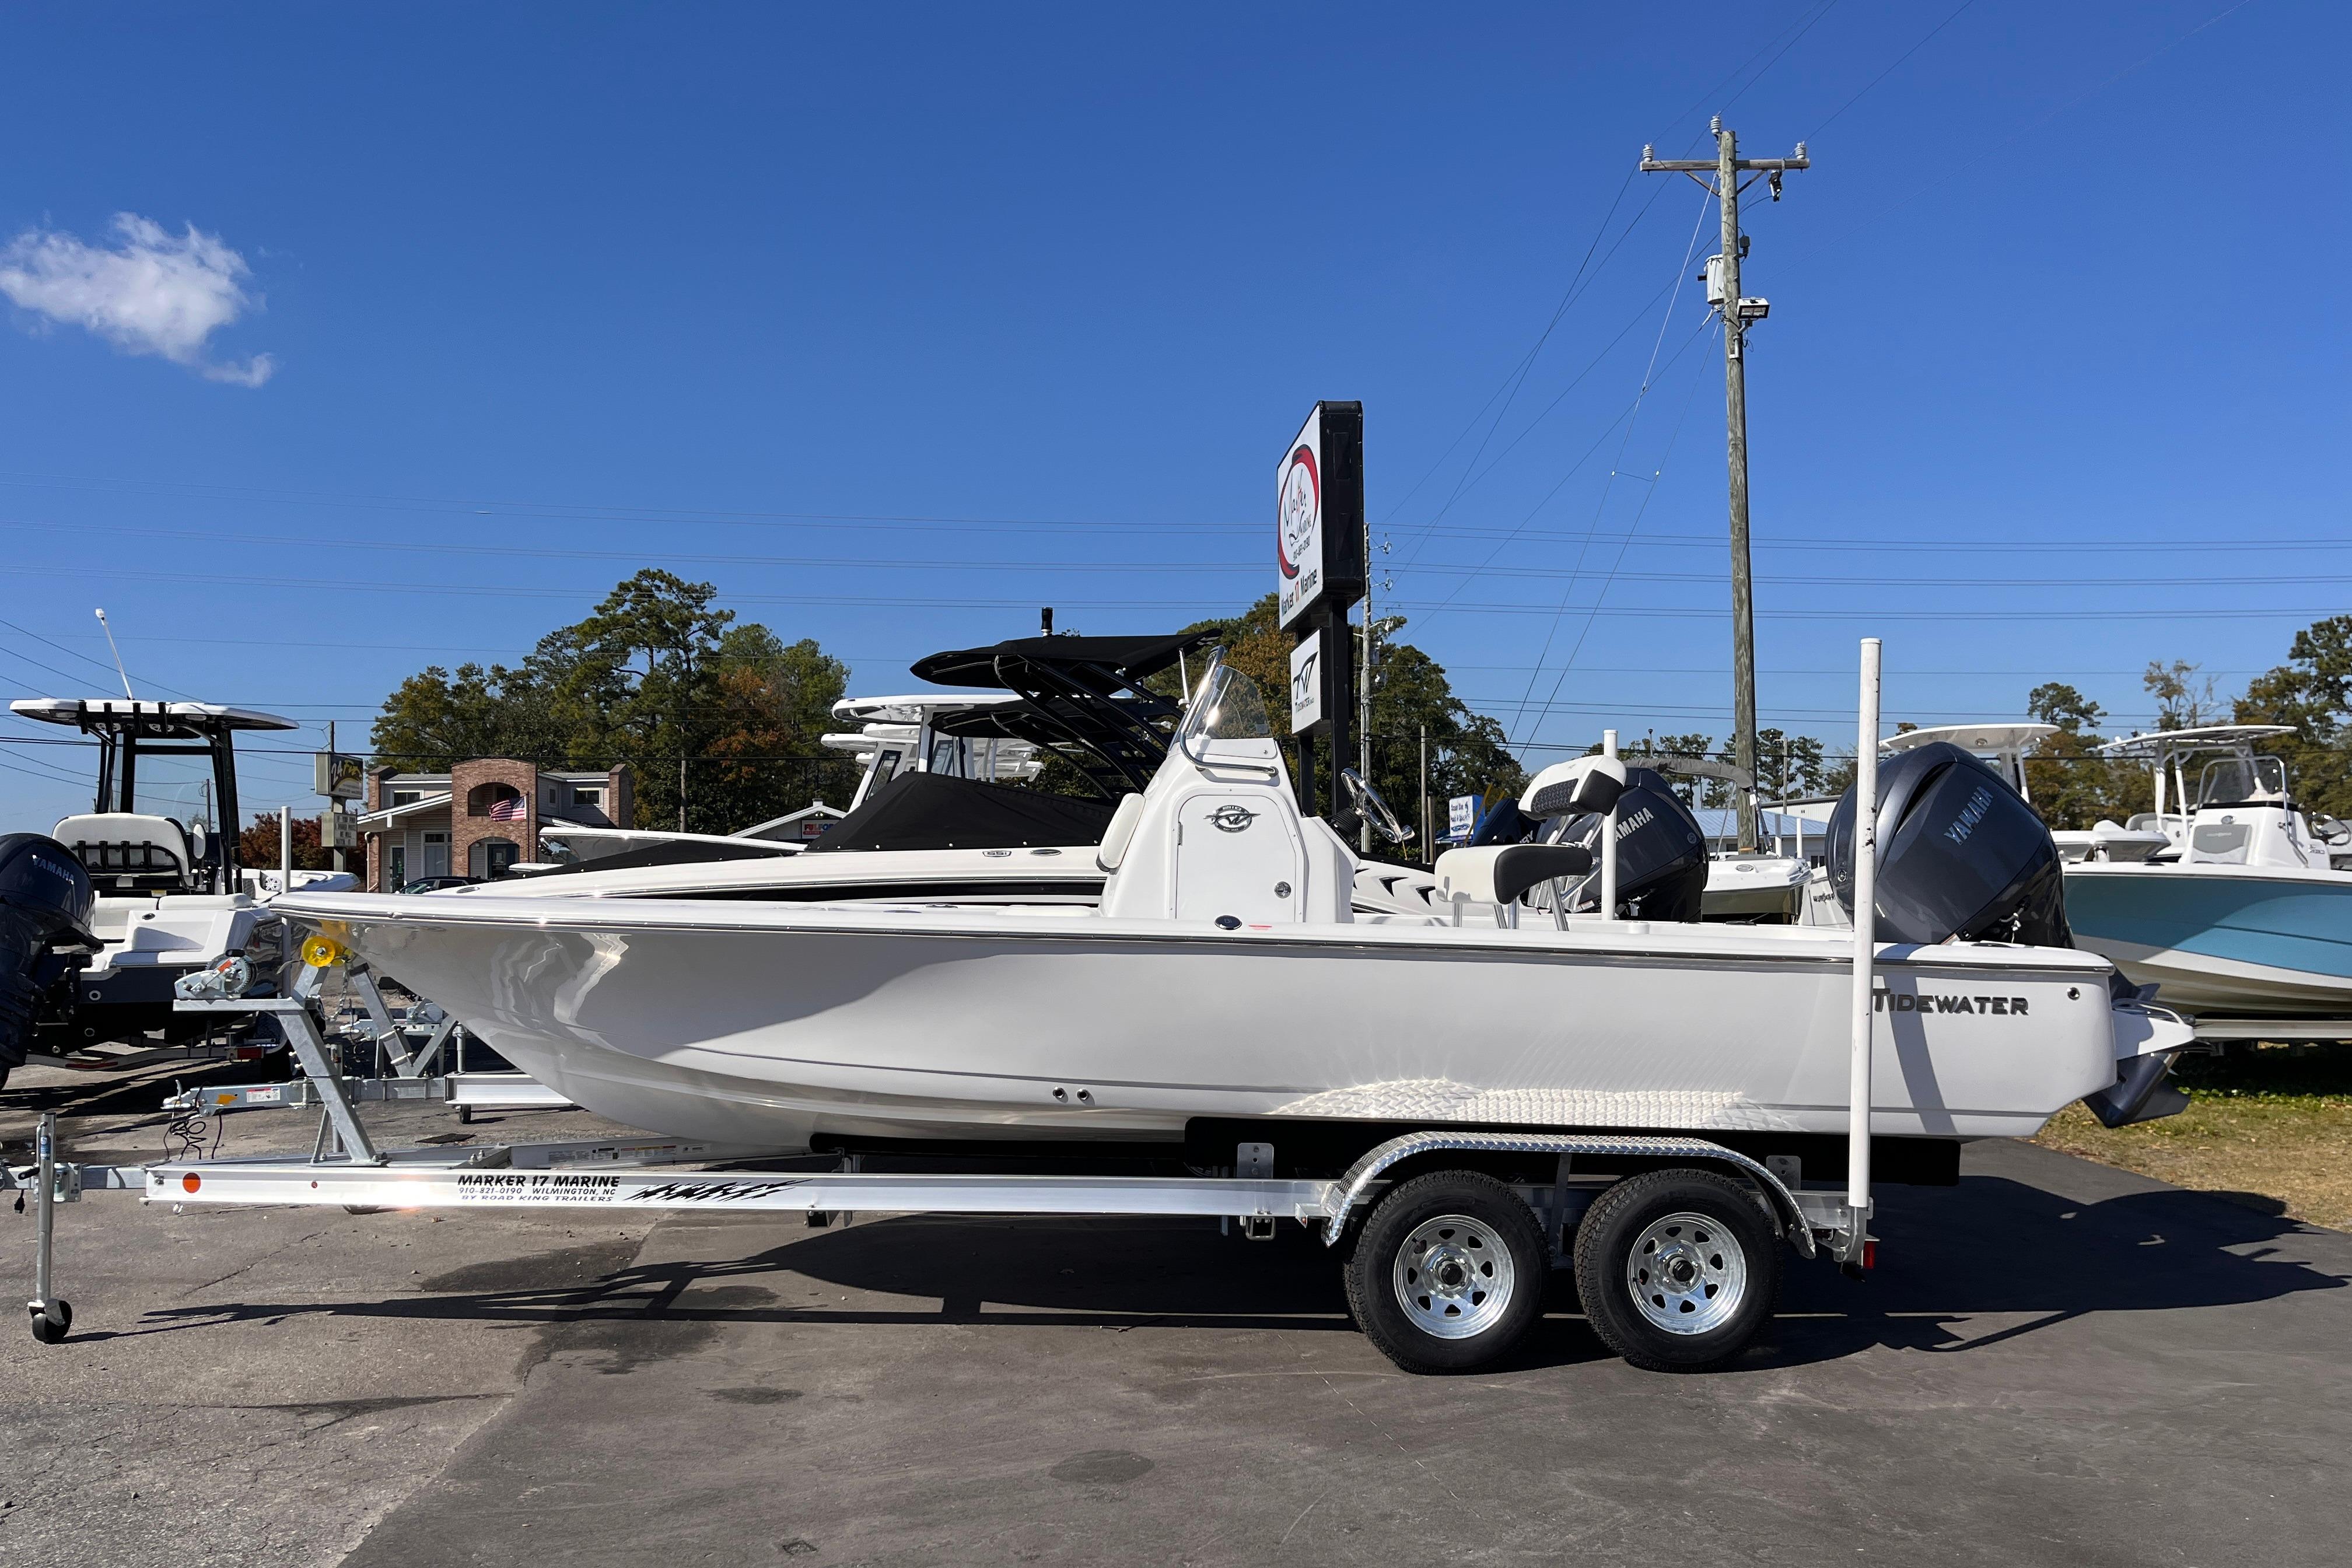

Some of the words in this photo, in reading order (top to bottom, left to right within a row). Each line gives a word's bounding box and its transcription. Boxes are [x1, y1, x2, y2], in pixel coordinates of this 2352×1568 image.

[1281, 591, 1294, 617] Marker
[1294, 580, 1299, 603] 17
[1300, 568, 1317, 597] Marine
[1615, 807, 1654, 843] AMAHA
[1944, 786, 1993, 845] YAMAHA
[32, 854, 75, 886] YAMAHA
[1873, 988, 2029, 1016] TIDEWATER
[457, 1175, 526, 1186] MARKER
[531, 1175, 550, 1186] 17
[553, 1175, 621, 1188] MARINE
[532, 1188, 598, 1196] WILMINGTON,
